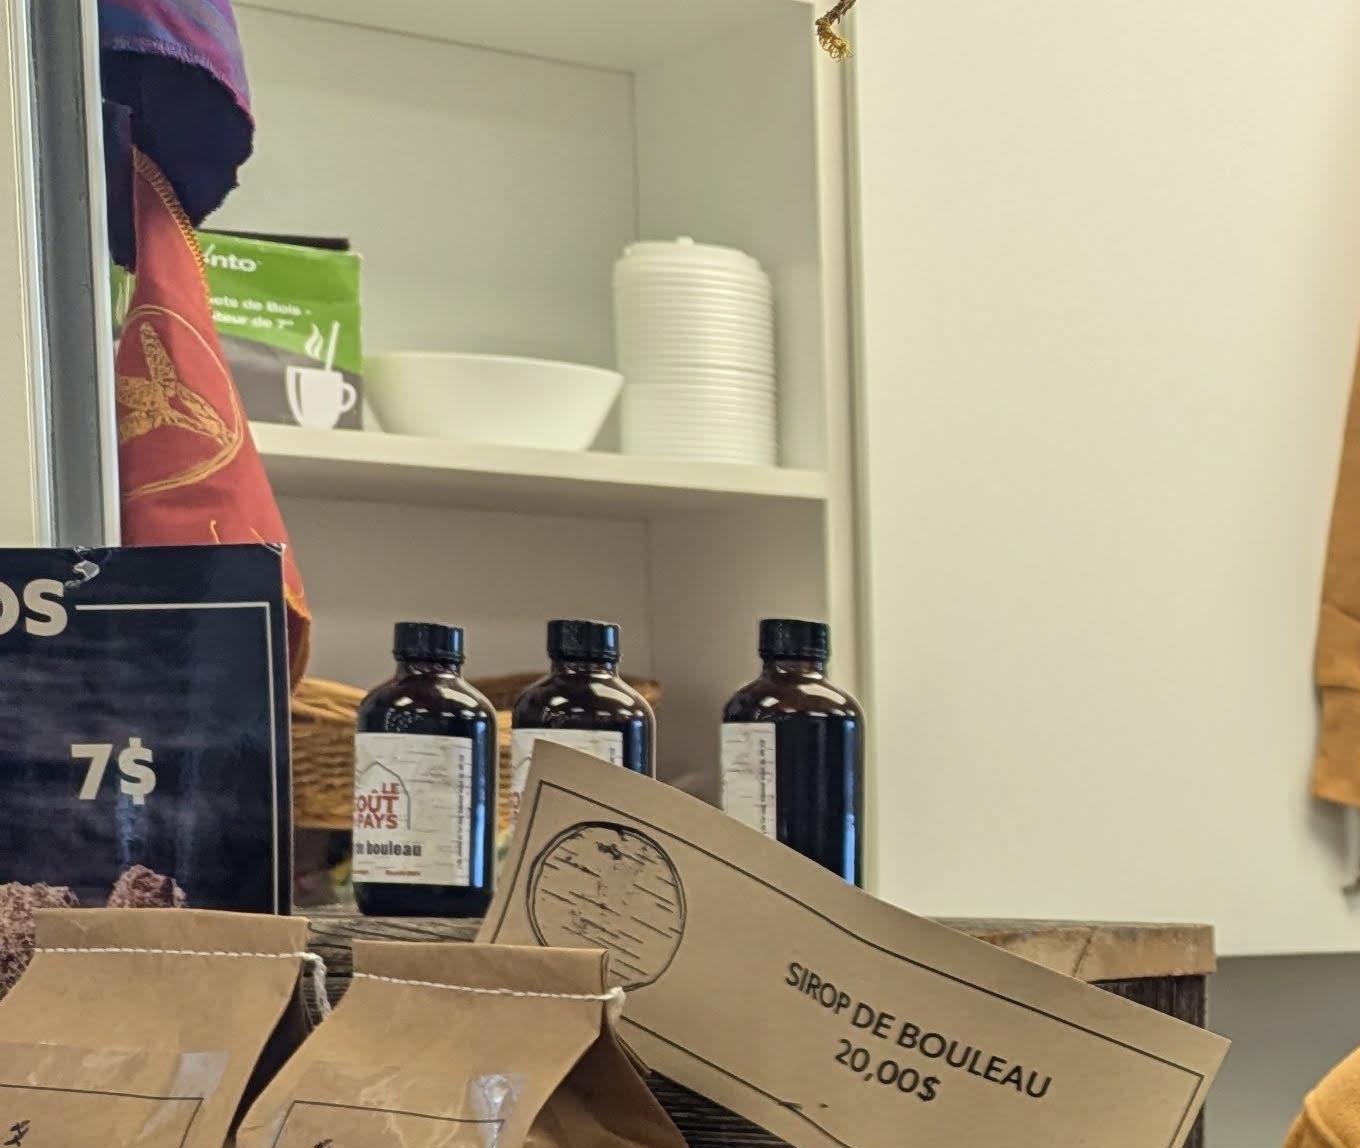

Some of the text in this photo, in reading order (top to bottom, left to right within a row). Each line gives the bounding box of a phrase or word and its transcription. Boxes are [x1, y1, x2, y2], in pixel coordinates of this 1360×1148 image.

[70, 737, 156, 805] 7$
[382, 782, 400, 795] LE
[356, 788, 399, 814] OÛT
[366, 840, 422, 857] bouleau
[784, 961, 1053, 1101] SIROP DE BOULEAU
[834, 1037, 943, 1103] 20,00$
